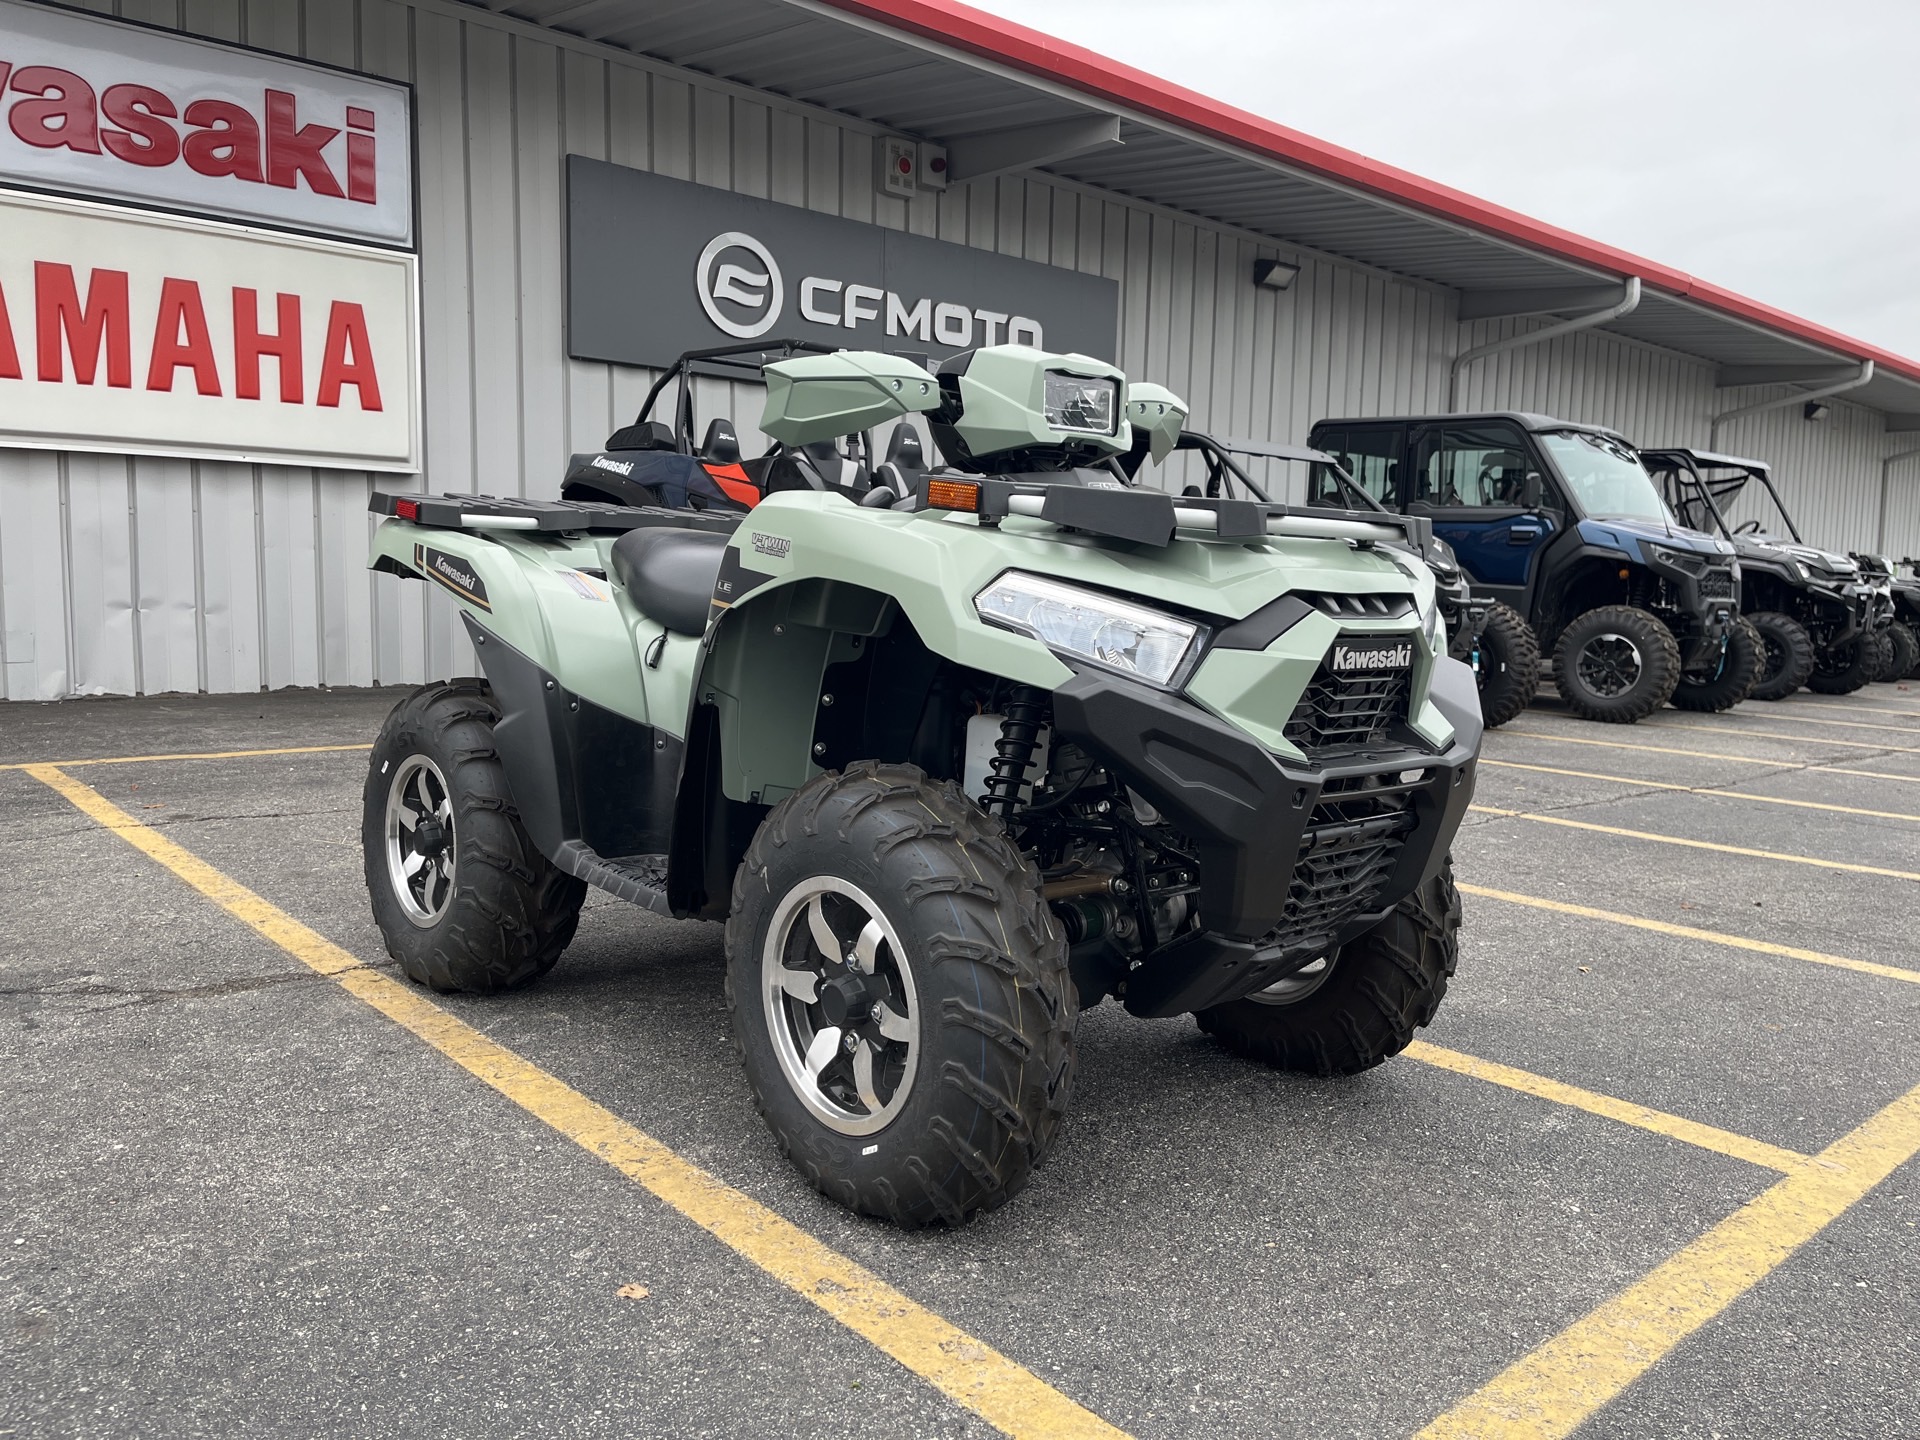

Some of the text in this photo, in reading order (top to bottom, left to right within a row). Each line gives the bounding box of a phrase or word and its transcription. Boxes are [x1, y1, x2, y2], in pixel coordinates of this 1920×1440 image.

[0, 61, 377, 205] asaki
[801, 277, 1043, 351] CFMOTO
[0, 260, 384, 413] MAHA
[591, 455, 635, 476] Kawasaki
[752, 532, 791, 552] V-TWIN
[435, 554, 476, 590] Kawasaki
[717, 581, 732, 592] LE
[1333, 644, 1412, 670] Kawasaki
